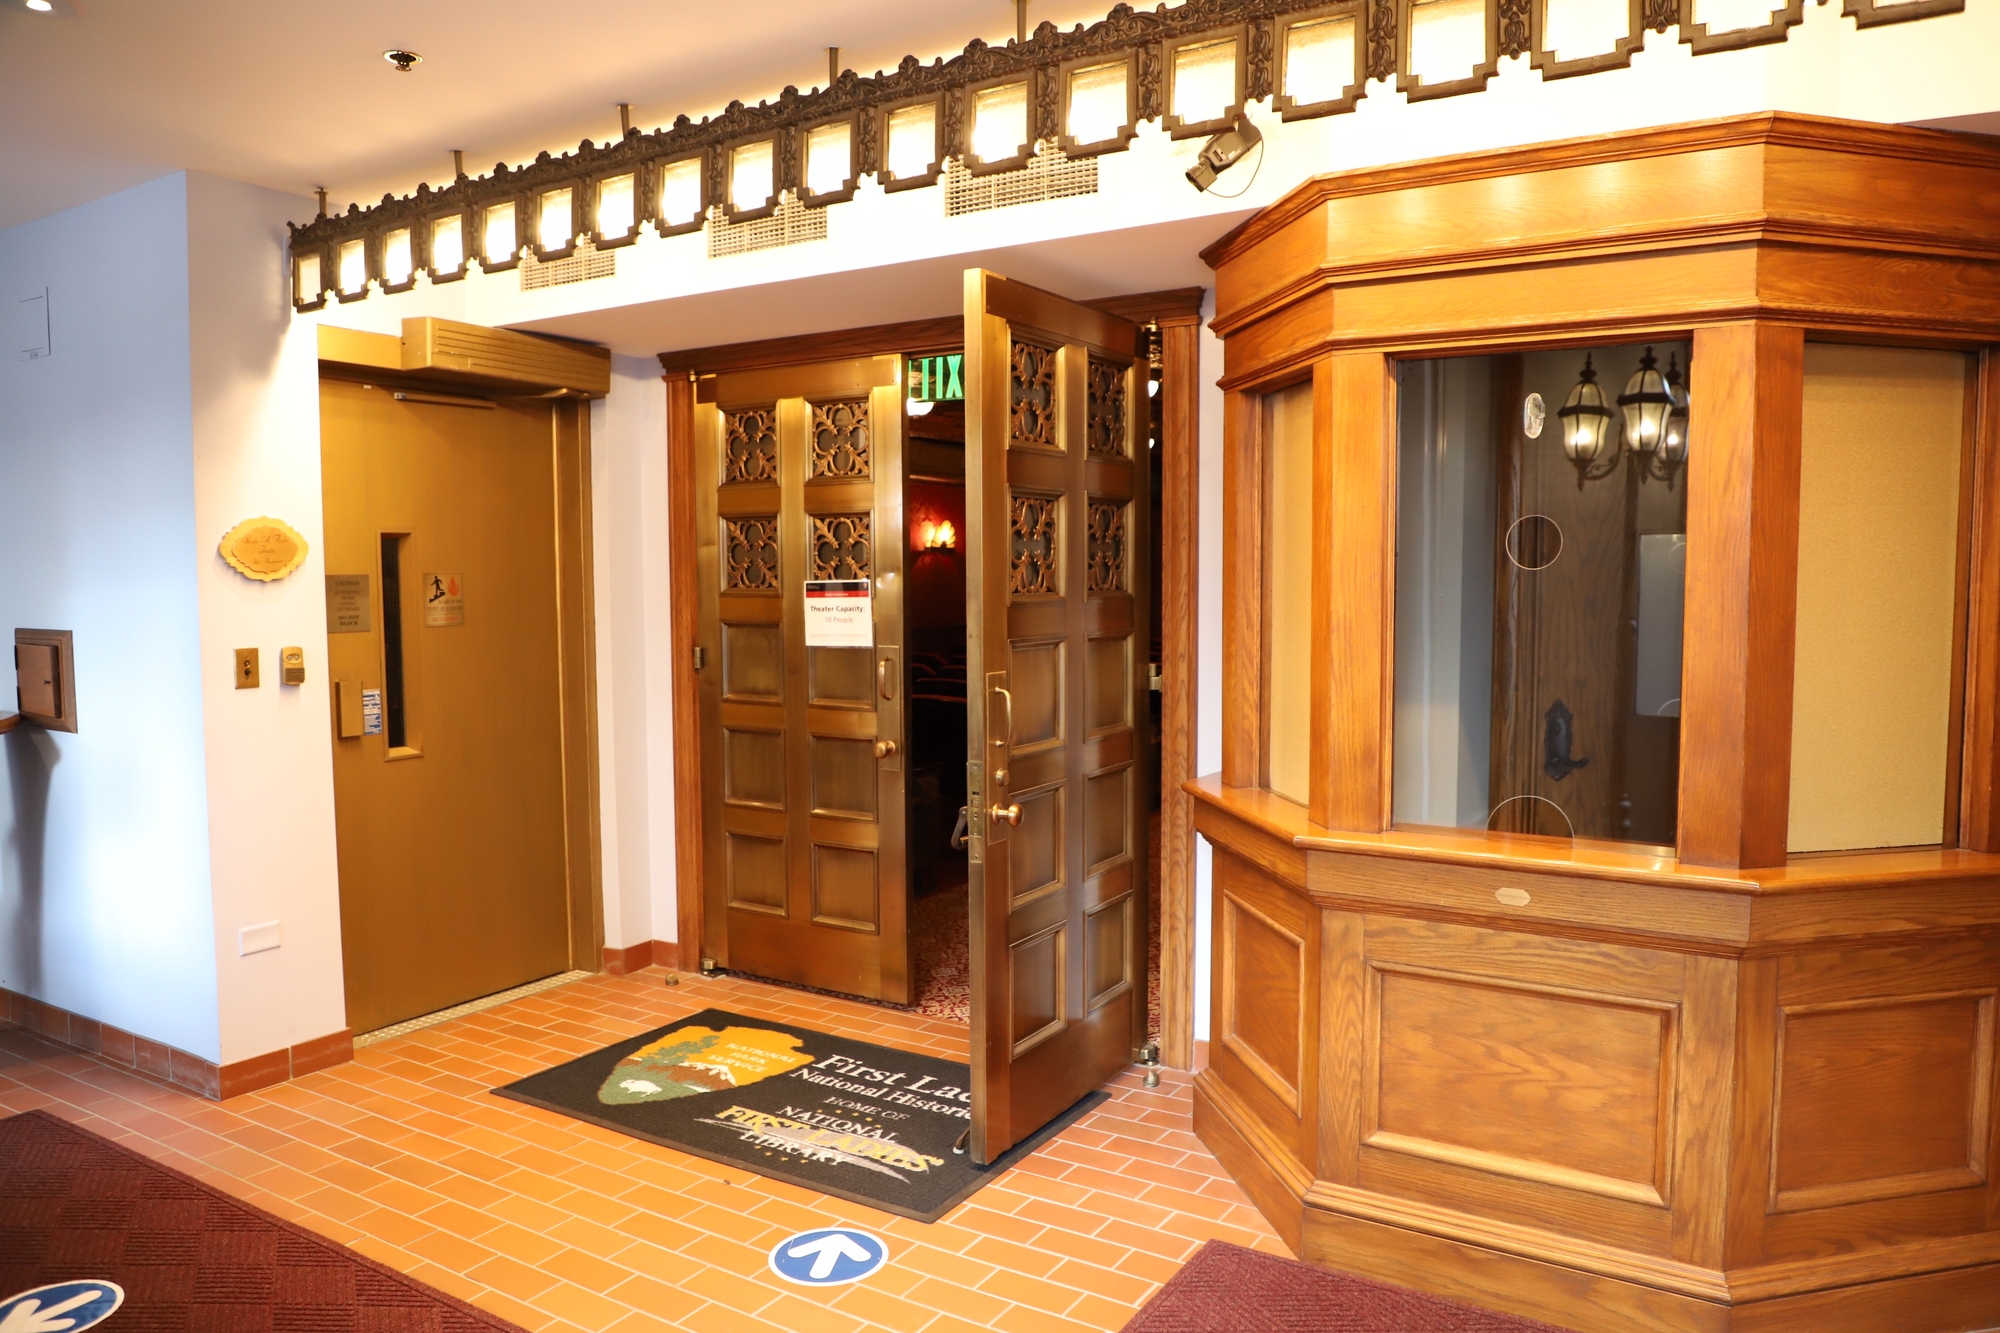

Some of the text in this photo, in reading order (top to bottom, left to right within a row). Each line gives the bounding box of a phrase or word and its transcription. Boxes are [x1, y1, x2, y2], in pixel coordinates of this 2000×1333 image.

[833, 616, 854, 624] People
[707, 1054, 768, 1073] SERVICE
[725, 1043, 797, 1063] NATIONAL
[730, 1051, 768, 1065] PARK
[789, 1067, 889, 1099] National
[811, 1053, 907, 1086] First
[715, 1104, 810, 1134] FIRST
[823, 1096, 911, 1121] HOME OF
[775, 1105, 900, 1144] NATIONAL
[738, 1131, 853, 1166] LIBRARY
